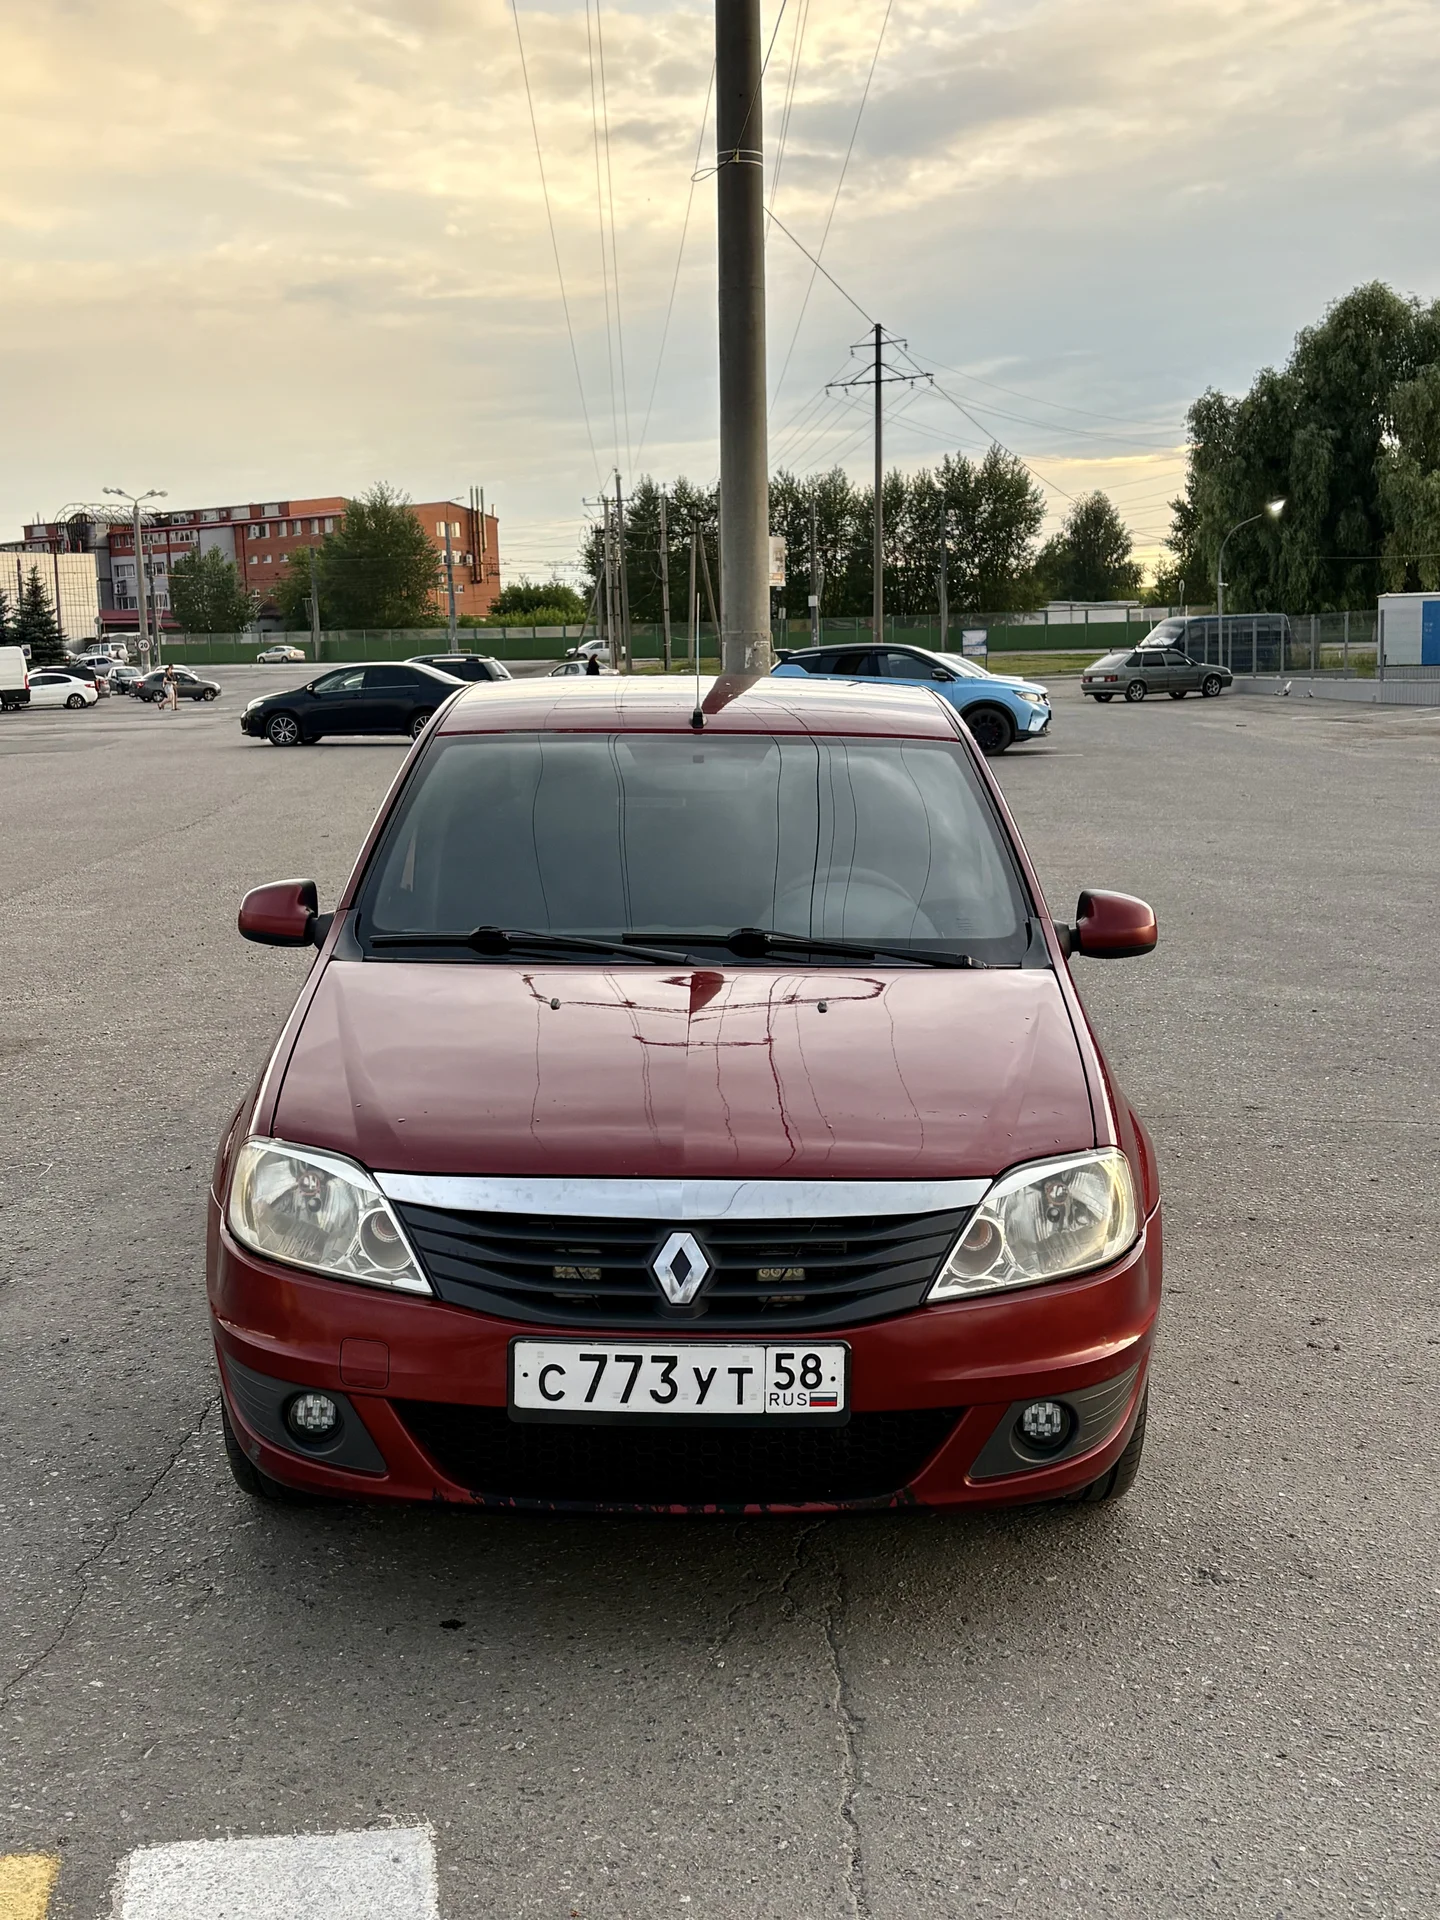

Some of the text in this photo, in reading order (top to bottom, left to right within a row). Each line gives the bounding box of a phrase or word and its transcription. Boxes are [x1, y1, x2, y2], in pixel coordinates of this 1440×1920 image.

[538, 1353, 753, 1405] С773УТ
[773, 1353, 823, 1390] 58
[769, 1392, 807, 1407] RUS
